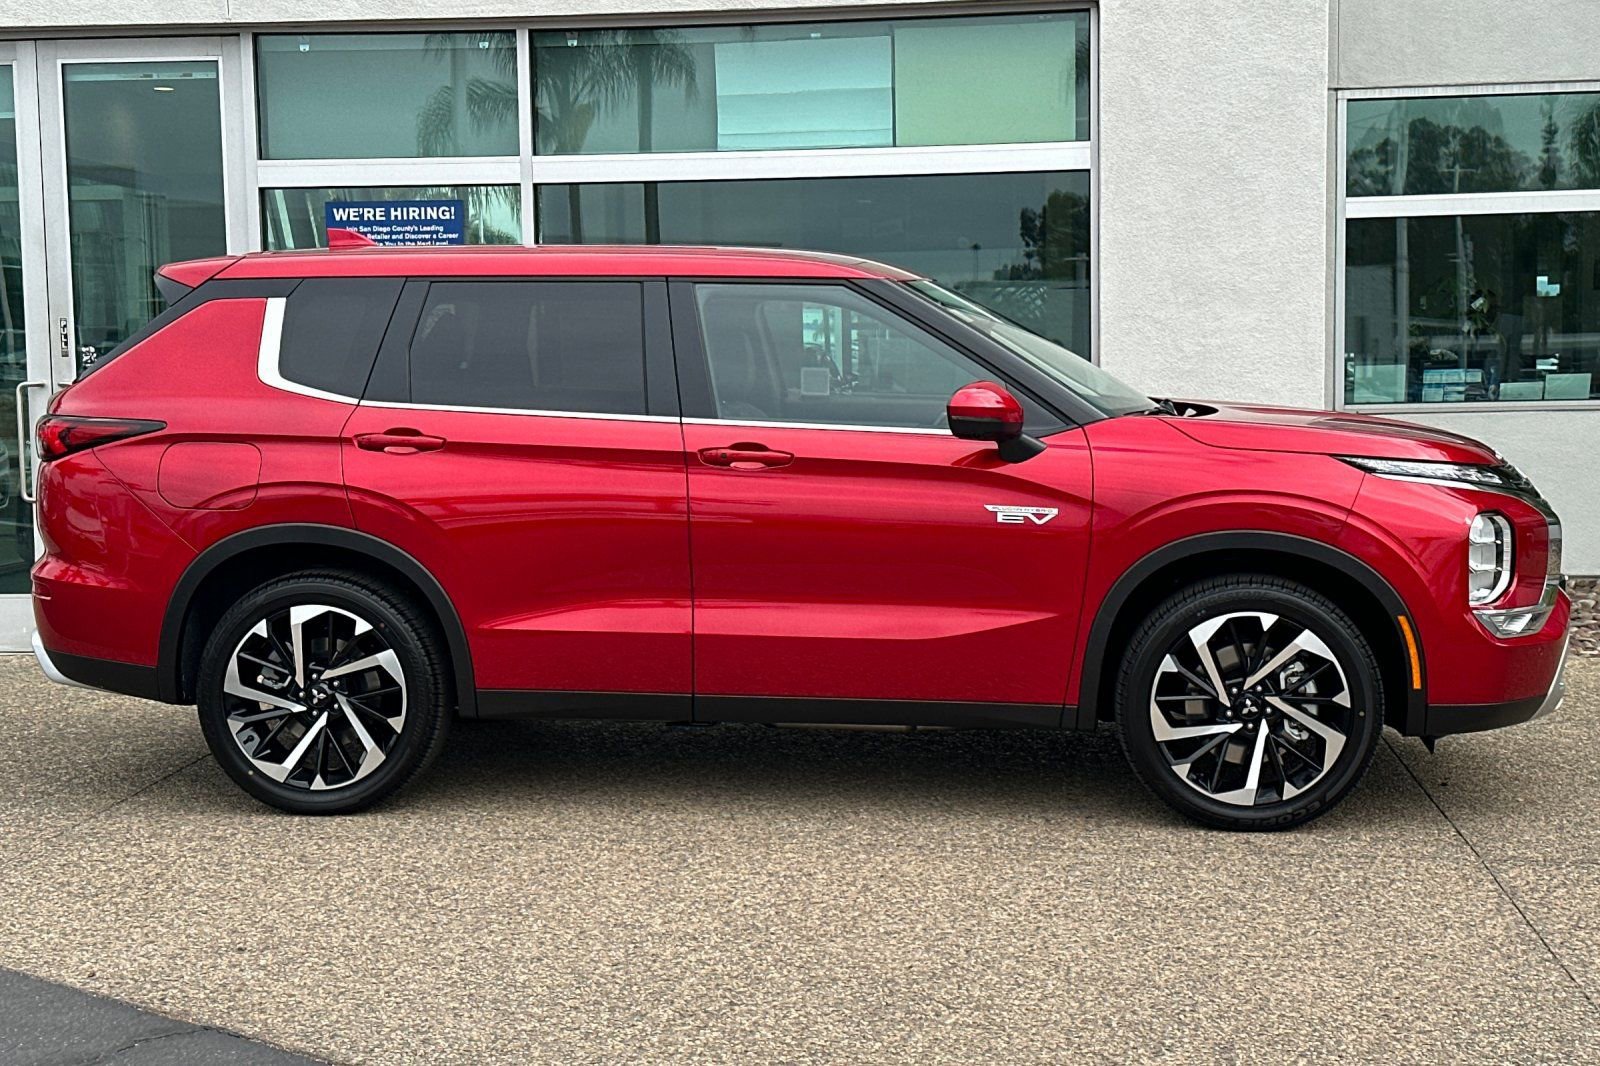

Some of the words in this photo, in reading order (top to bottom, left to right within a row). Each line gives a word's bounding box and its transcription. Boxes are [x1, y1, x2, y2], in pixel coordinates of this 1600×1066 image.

[333, 207, 386, 221] WE'RE
[390, 206, 455, 220] HIRING!
[372, 225, 391, 233] Diego
[391, 225, 418, 233] County's
[419, 224, 444, 232] Leading
[60, 320, 68, 348] PULL
[997, 511, 1059, 525] EV
